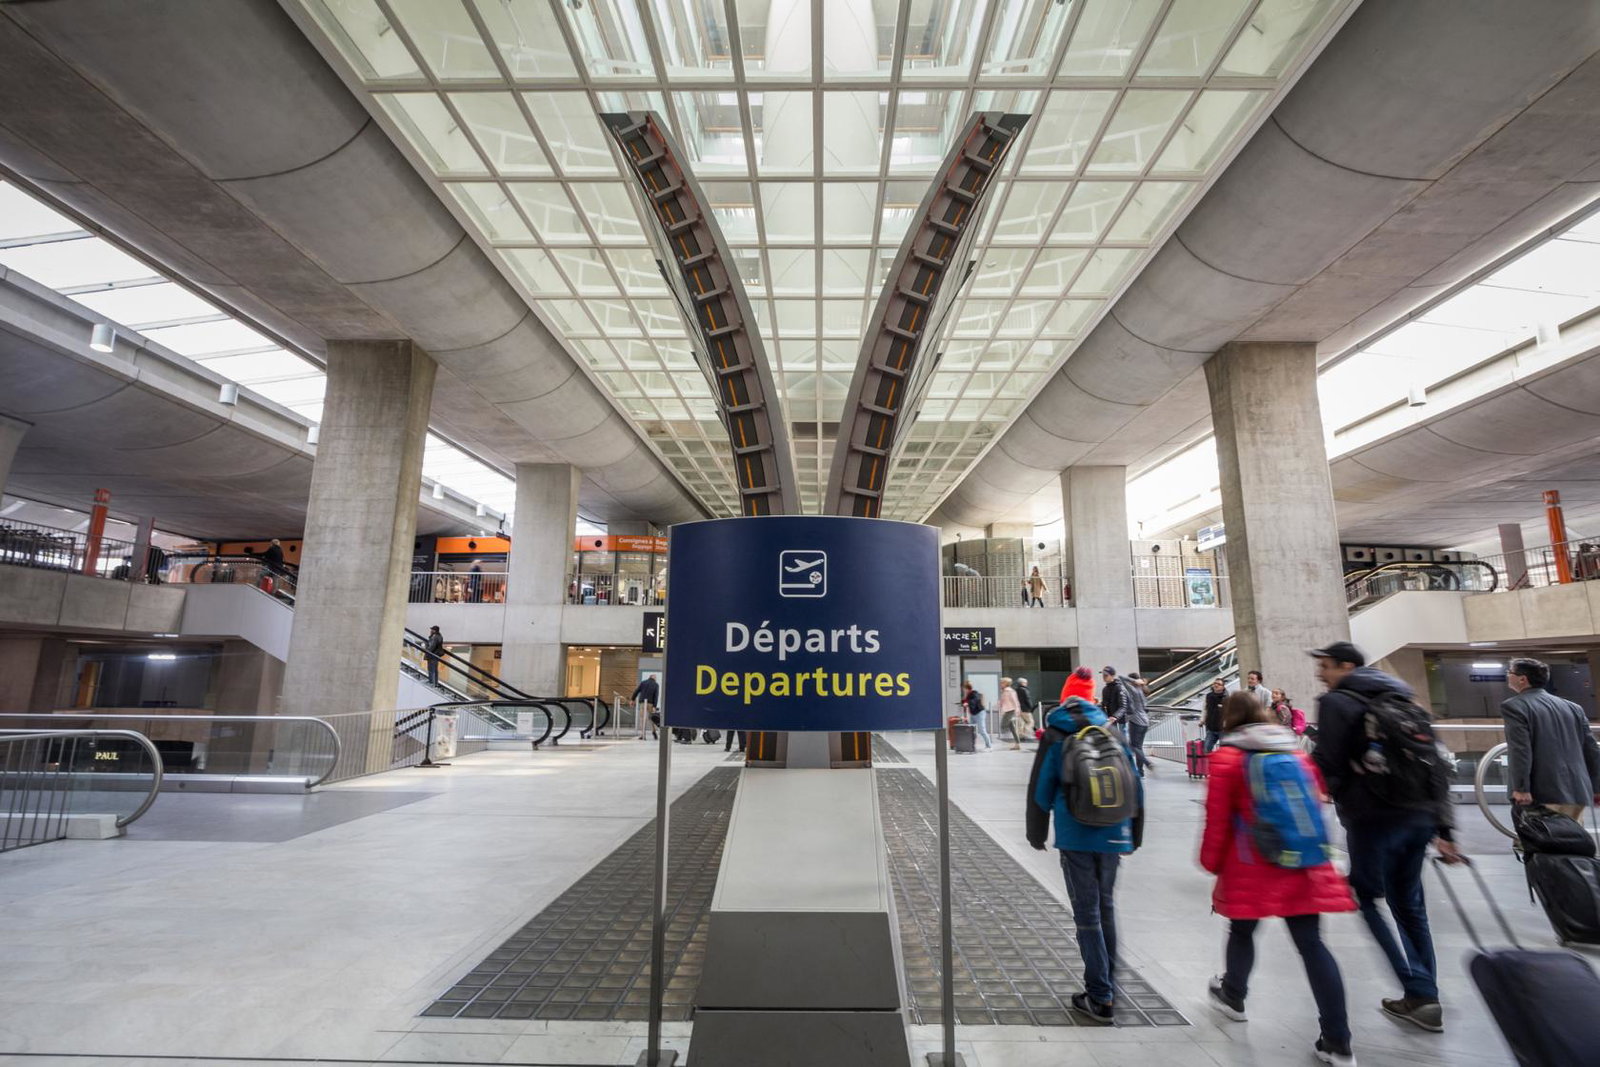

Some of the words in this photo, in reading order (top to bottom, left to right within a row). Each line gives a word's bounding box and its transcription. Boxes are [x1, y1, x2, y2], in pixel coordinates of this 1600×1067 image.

[726, 620, 880, 660] Départs
[695, 665, 911, 704] Departures
[94, 751, 119, 760] PAUL
